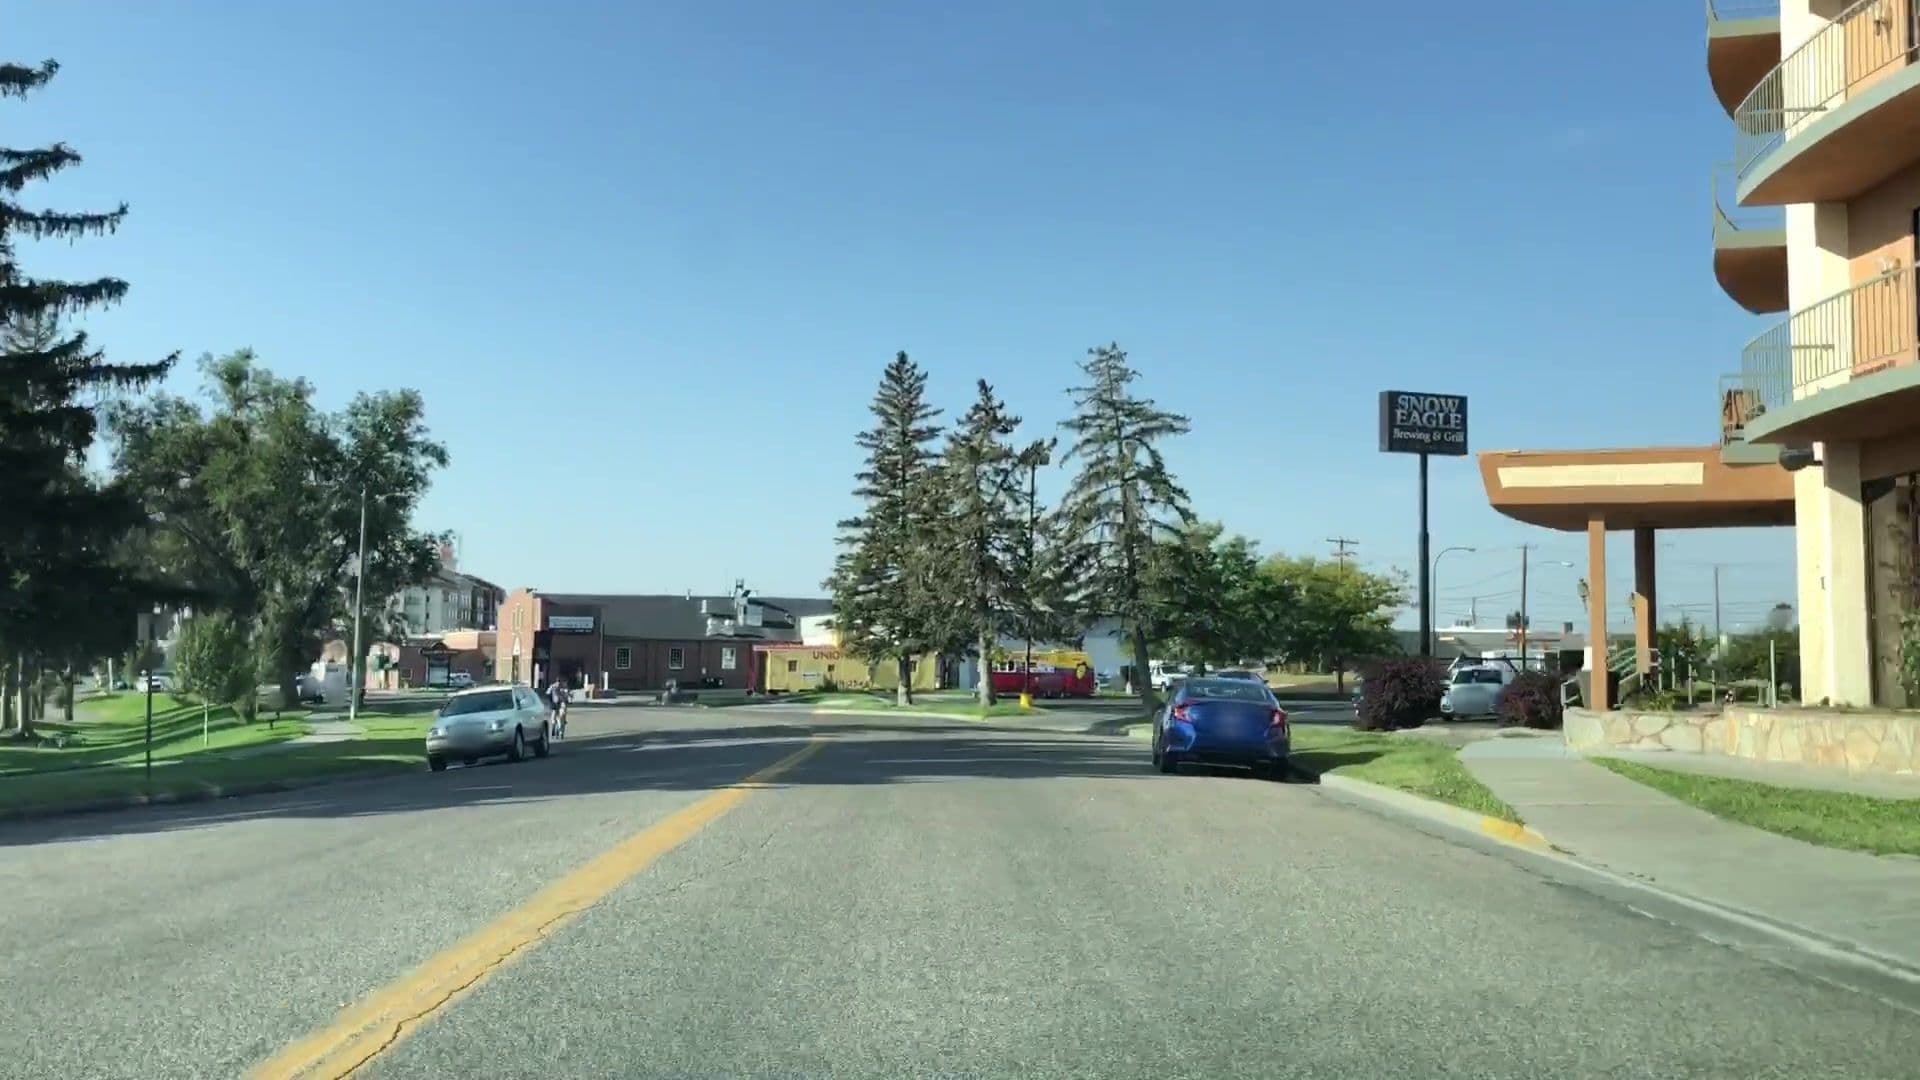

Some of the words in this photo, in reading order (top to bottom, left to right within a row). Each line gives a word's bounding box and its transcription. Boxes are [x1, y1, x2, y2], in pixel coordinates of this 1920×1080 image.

[1397, 395, 1460, 413] SNOW
[1395, 409, 1463, 429] EAGLE
[1393, 428, 1431, 443] Brewing
[1432, 431, 1442, 441] &
[1443, 431, 1464, 442] Grill
[812, 650, 847, 660] UNIO
